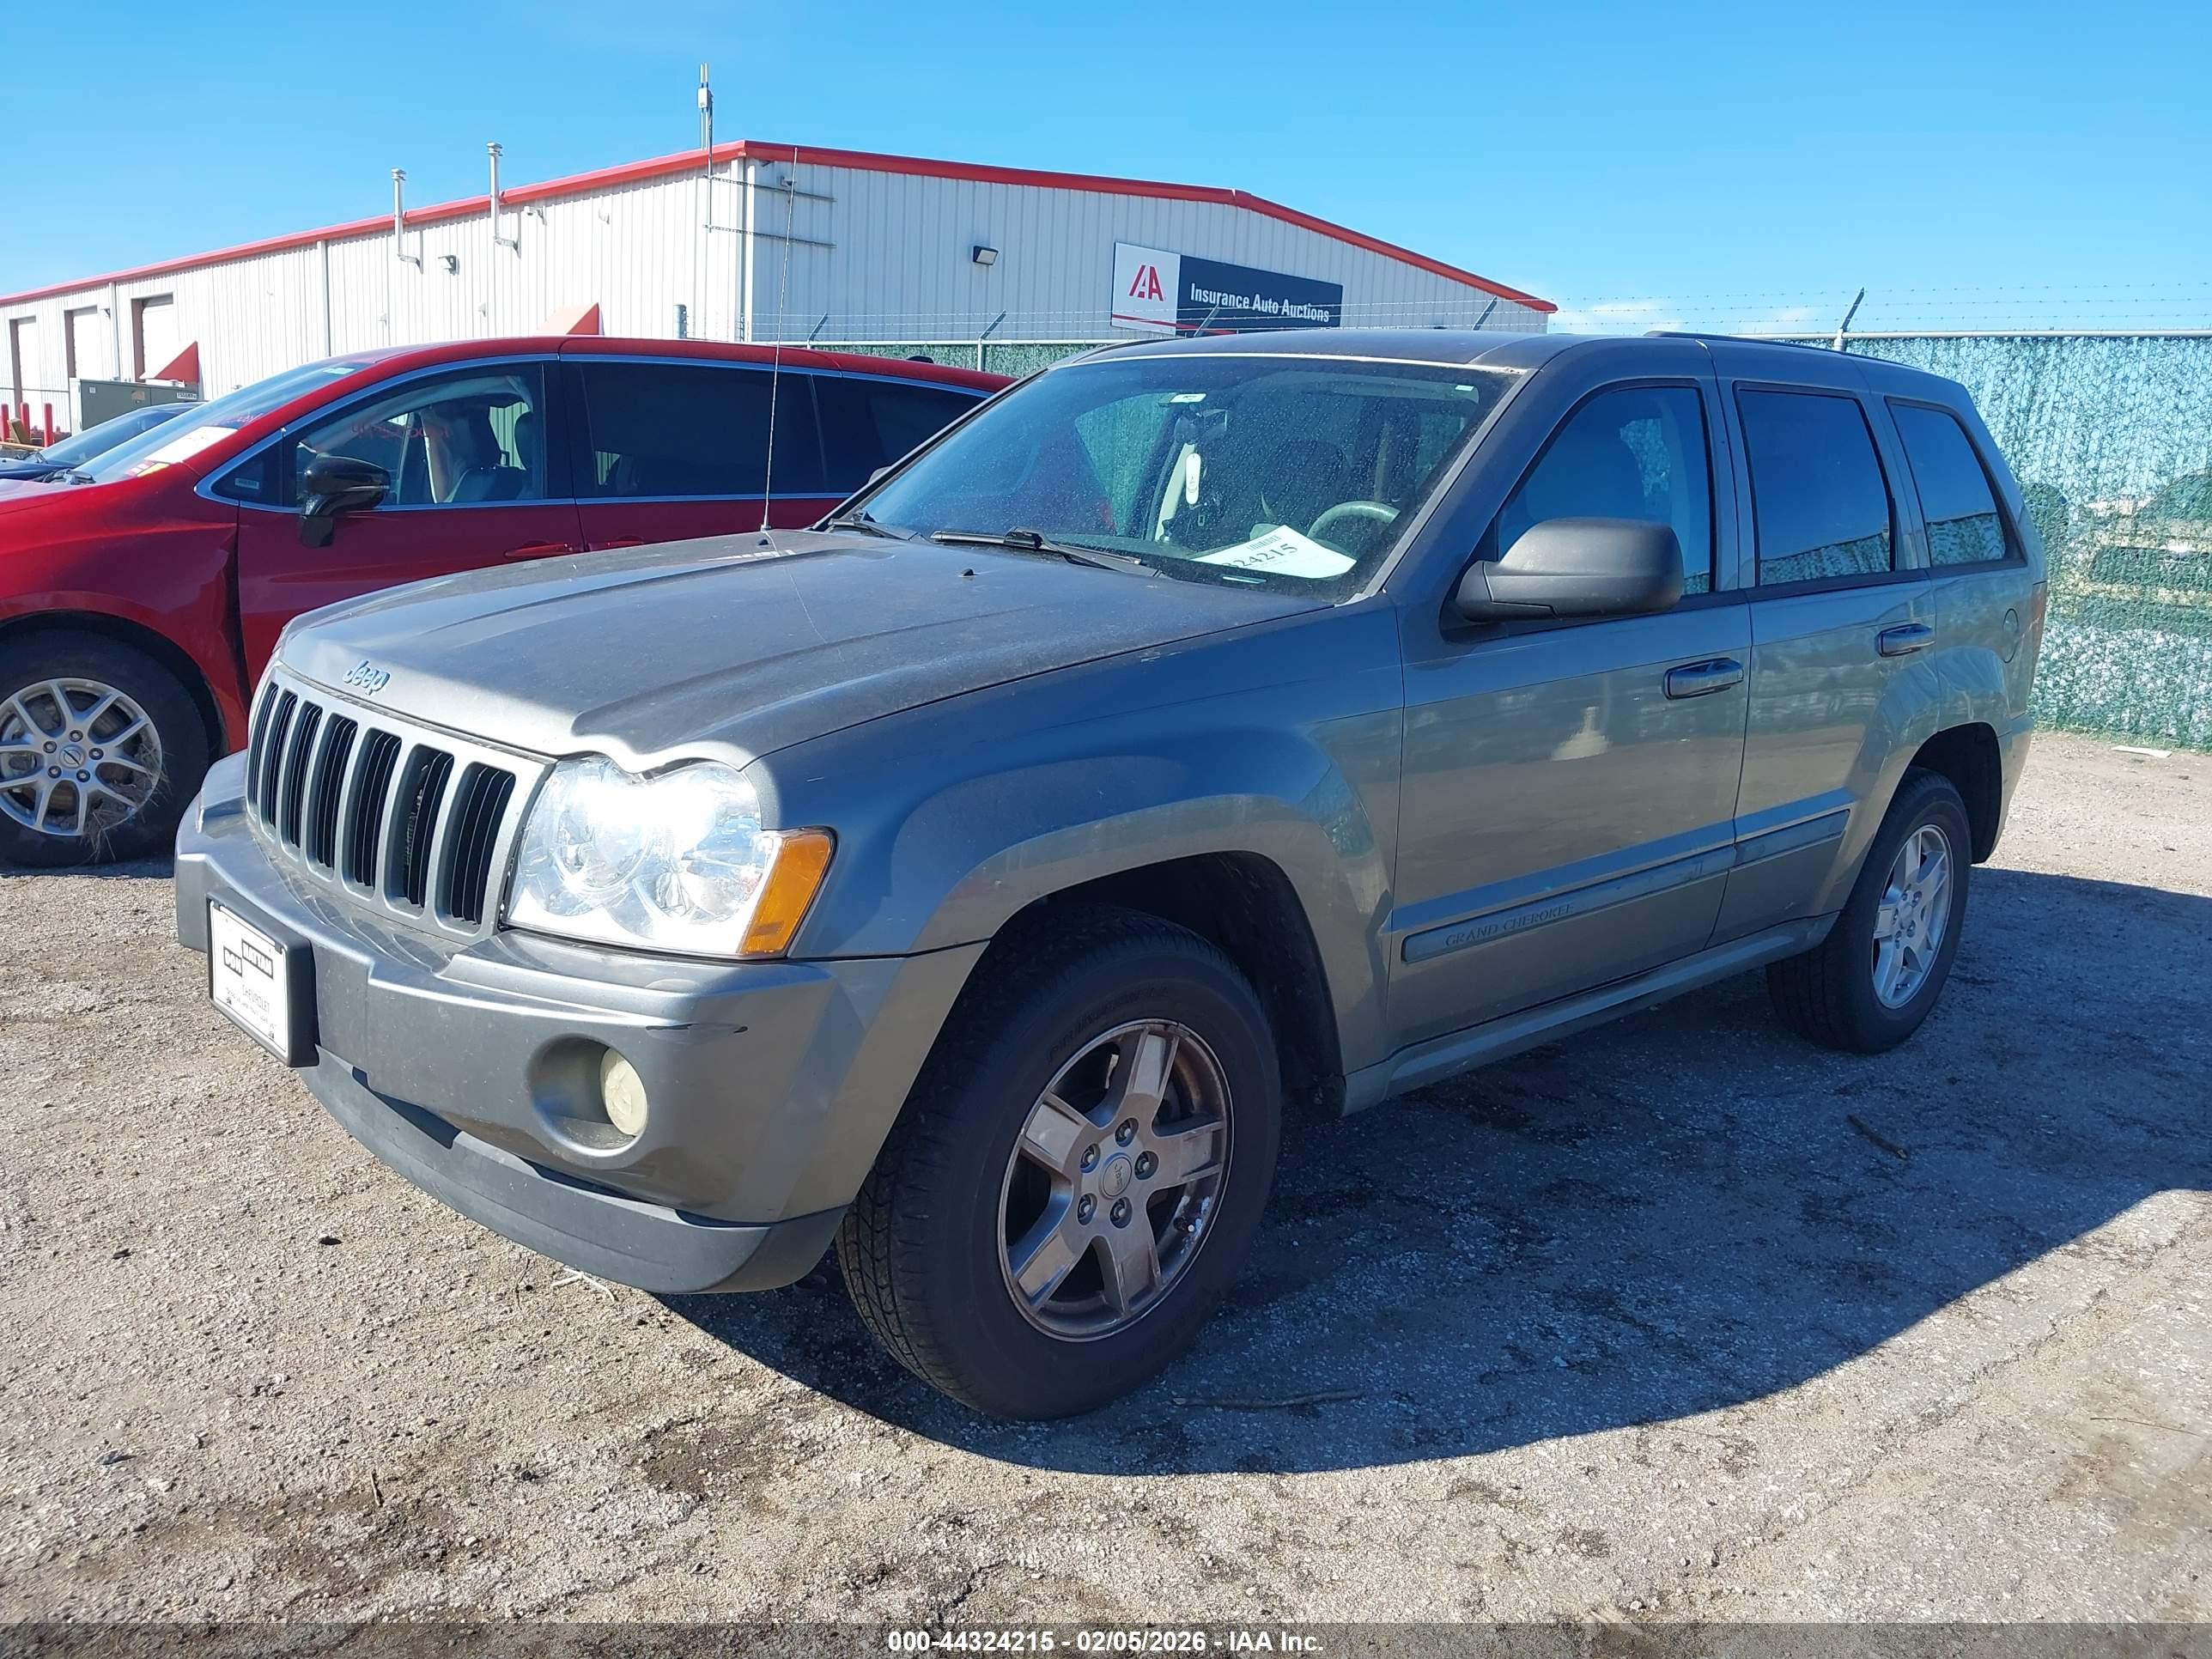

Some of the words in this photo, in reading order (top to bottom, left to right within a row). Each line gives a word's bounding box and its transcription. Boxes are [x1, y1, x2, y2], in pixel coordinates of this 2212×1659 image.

[1191, 283, 1249, 310] Insurance
[1253, 294, 1279, 314] Auto
[1281, 298, 1330, 323] Auctions
[343, 659, 390, 696] Jeep
[1445, 923, 1498, 946] GRAND
[1504, 903, 1574, 930] CHEROKEE
